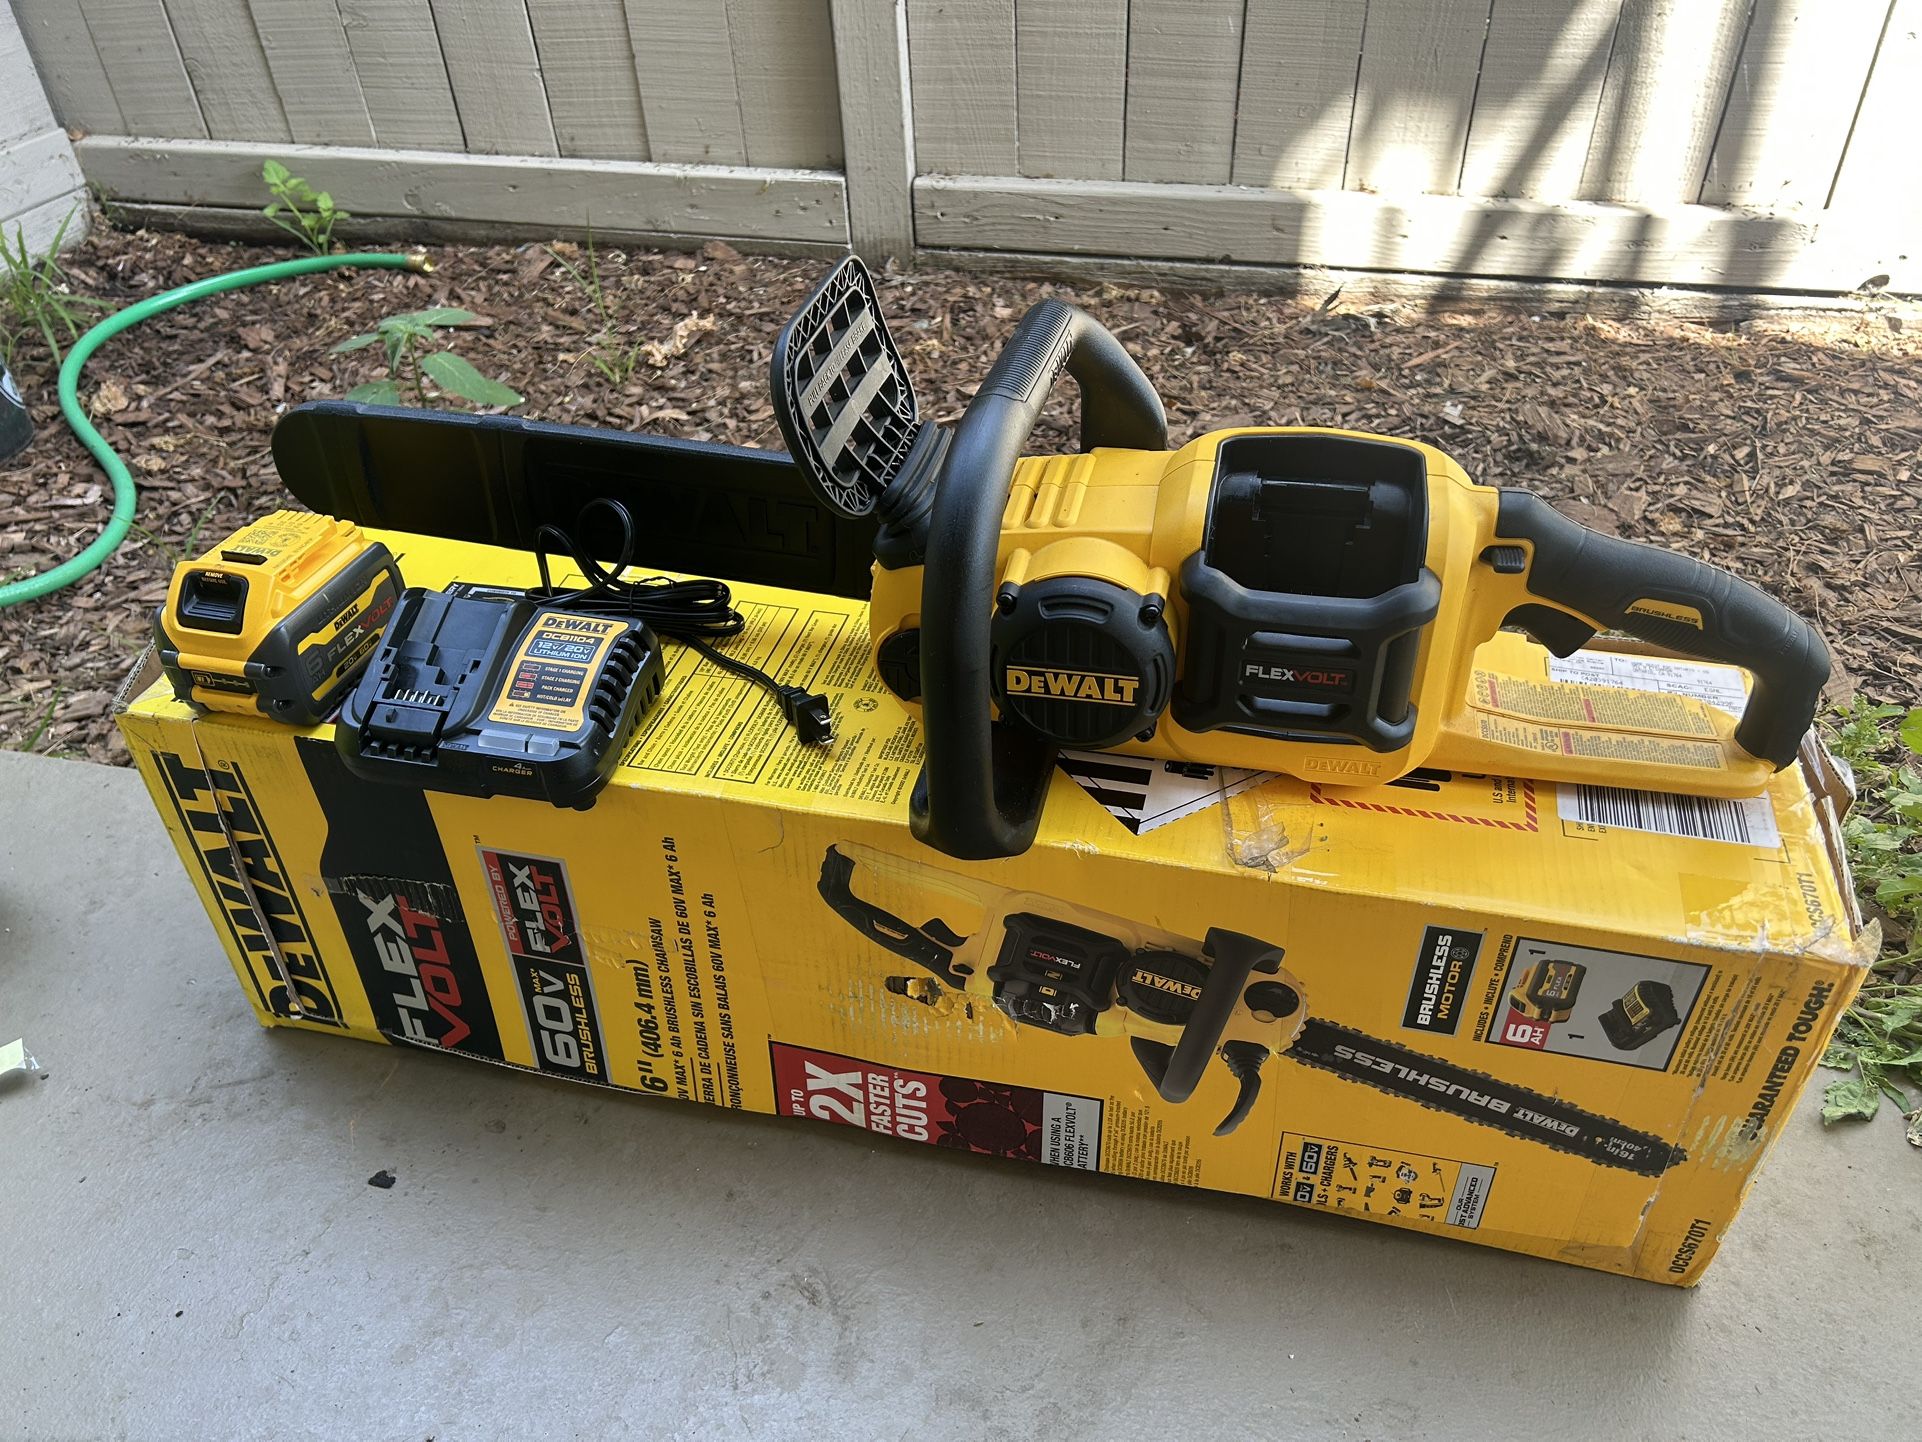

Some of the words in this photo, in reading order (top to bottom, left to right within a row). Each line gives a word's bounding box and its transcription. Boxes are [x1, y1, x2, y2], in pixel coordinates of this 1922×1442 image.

[543, 617, 613, 635] DEWALT
[1631, 606, 1699, 624] BRUSHLESS
[542, 632, 595, 644] DCB1104
[534, 648, 572, 658] LITHIUM
[1006, 667, 1139, 703] DEWALT
[1245, 664, 1348, 686] FLEXVOLT
[492, 765, 533, 776] CHARGER
[1305, 757, 1381, 777] DEWALT
[1493, 792, 1503, 804] U.S
[662, 837, 676, 852] Ah
[665, 854, 678, 862] 6
[489, 864, 502, 882] BY
[158, 752, 336, 1023] DEWALT
[495, 884, 518, 942] POWERED
[508, 861, 551, 953] FLEX
[529, 864, 572, 954] VOLT
[673, 897, 688, 918] 60V
[701, 893, 715, 909] Ah
[704, 910, 717, 918] 6
[677, 920, 691, 935] DE
[649, 916, 670, 974] CHAINSAW
[1528, 948, 1547, 956] 1
[356, 887, 441, 1044] FLEX
[395, 894, 471, 1048] VOLT
[680, 937, 702, 1000] ESCOBILLAS
[710, 951, 725, 972] 60V
[1030, 950, 1081, 970] FLEXVOLT
[625, 959, 654, 1000] mm)
[712, 973, 730, 1011] BALAIS
[1417, 934, 1453, 1026] BRUSHLESS
[1436, 960, 1463, 1020] MOTOR
[1472, 1007, 1490, 1043] INCLUDES
[1484, 977, 1499, 1006] INCLUYE
[1493, 934, 1514, 973] COMPREND
[660, 975, 680, 1033] BRUSHLESS
[690, 1001, 705, 1019] SIN
[532, 969, 581, 1068] 60V
[566, 973, 598, 1075] BRUSHLESS
[636, 999, 665, 1059] (406.4
[719, 1012, 734, 1040] SANS
[670, 1035, 682, 1049] Ah
[694, 1021, 709, 1059] CADENA
[1505, 1023, 1533, 1044] 6
[1530, 1027, 1546, 1046] AH
[1568, 1032, 1585, 1041] 1
[672, 1050, 683, 1058] 6
[700, 1061, 712, 1075] DE
[1334, 1044, 1511, 1115] BRUSHLESS
[790, 1089, 804, 1102] TO
[804, 1060, 867, 1128] 2X
[867, 1072, 893, 1136] FASTER
[791, 1102, 806, 1116] UP
[1050, 1123, 1061, 1147] USING
[1514, 1107, 1580, 1138] DEWALT
[1284, 1151, 1297, 1170] WITH
[1301, 1143, 1320, 1173] 60V
[1320, 1144, 1339, 1188] CHARGERS
[1279, 1169, 1294, 1197] WORKS
[1463, 1176, 1479, 1214] ADVANCED
[1455, 1197, 1464, 1211] OUR
[1467, 1194, 1481, 1220] SYSTEM
[1669, 1218, 1712, 1274] DCCS670T1
